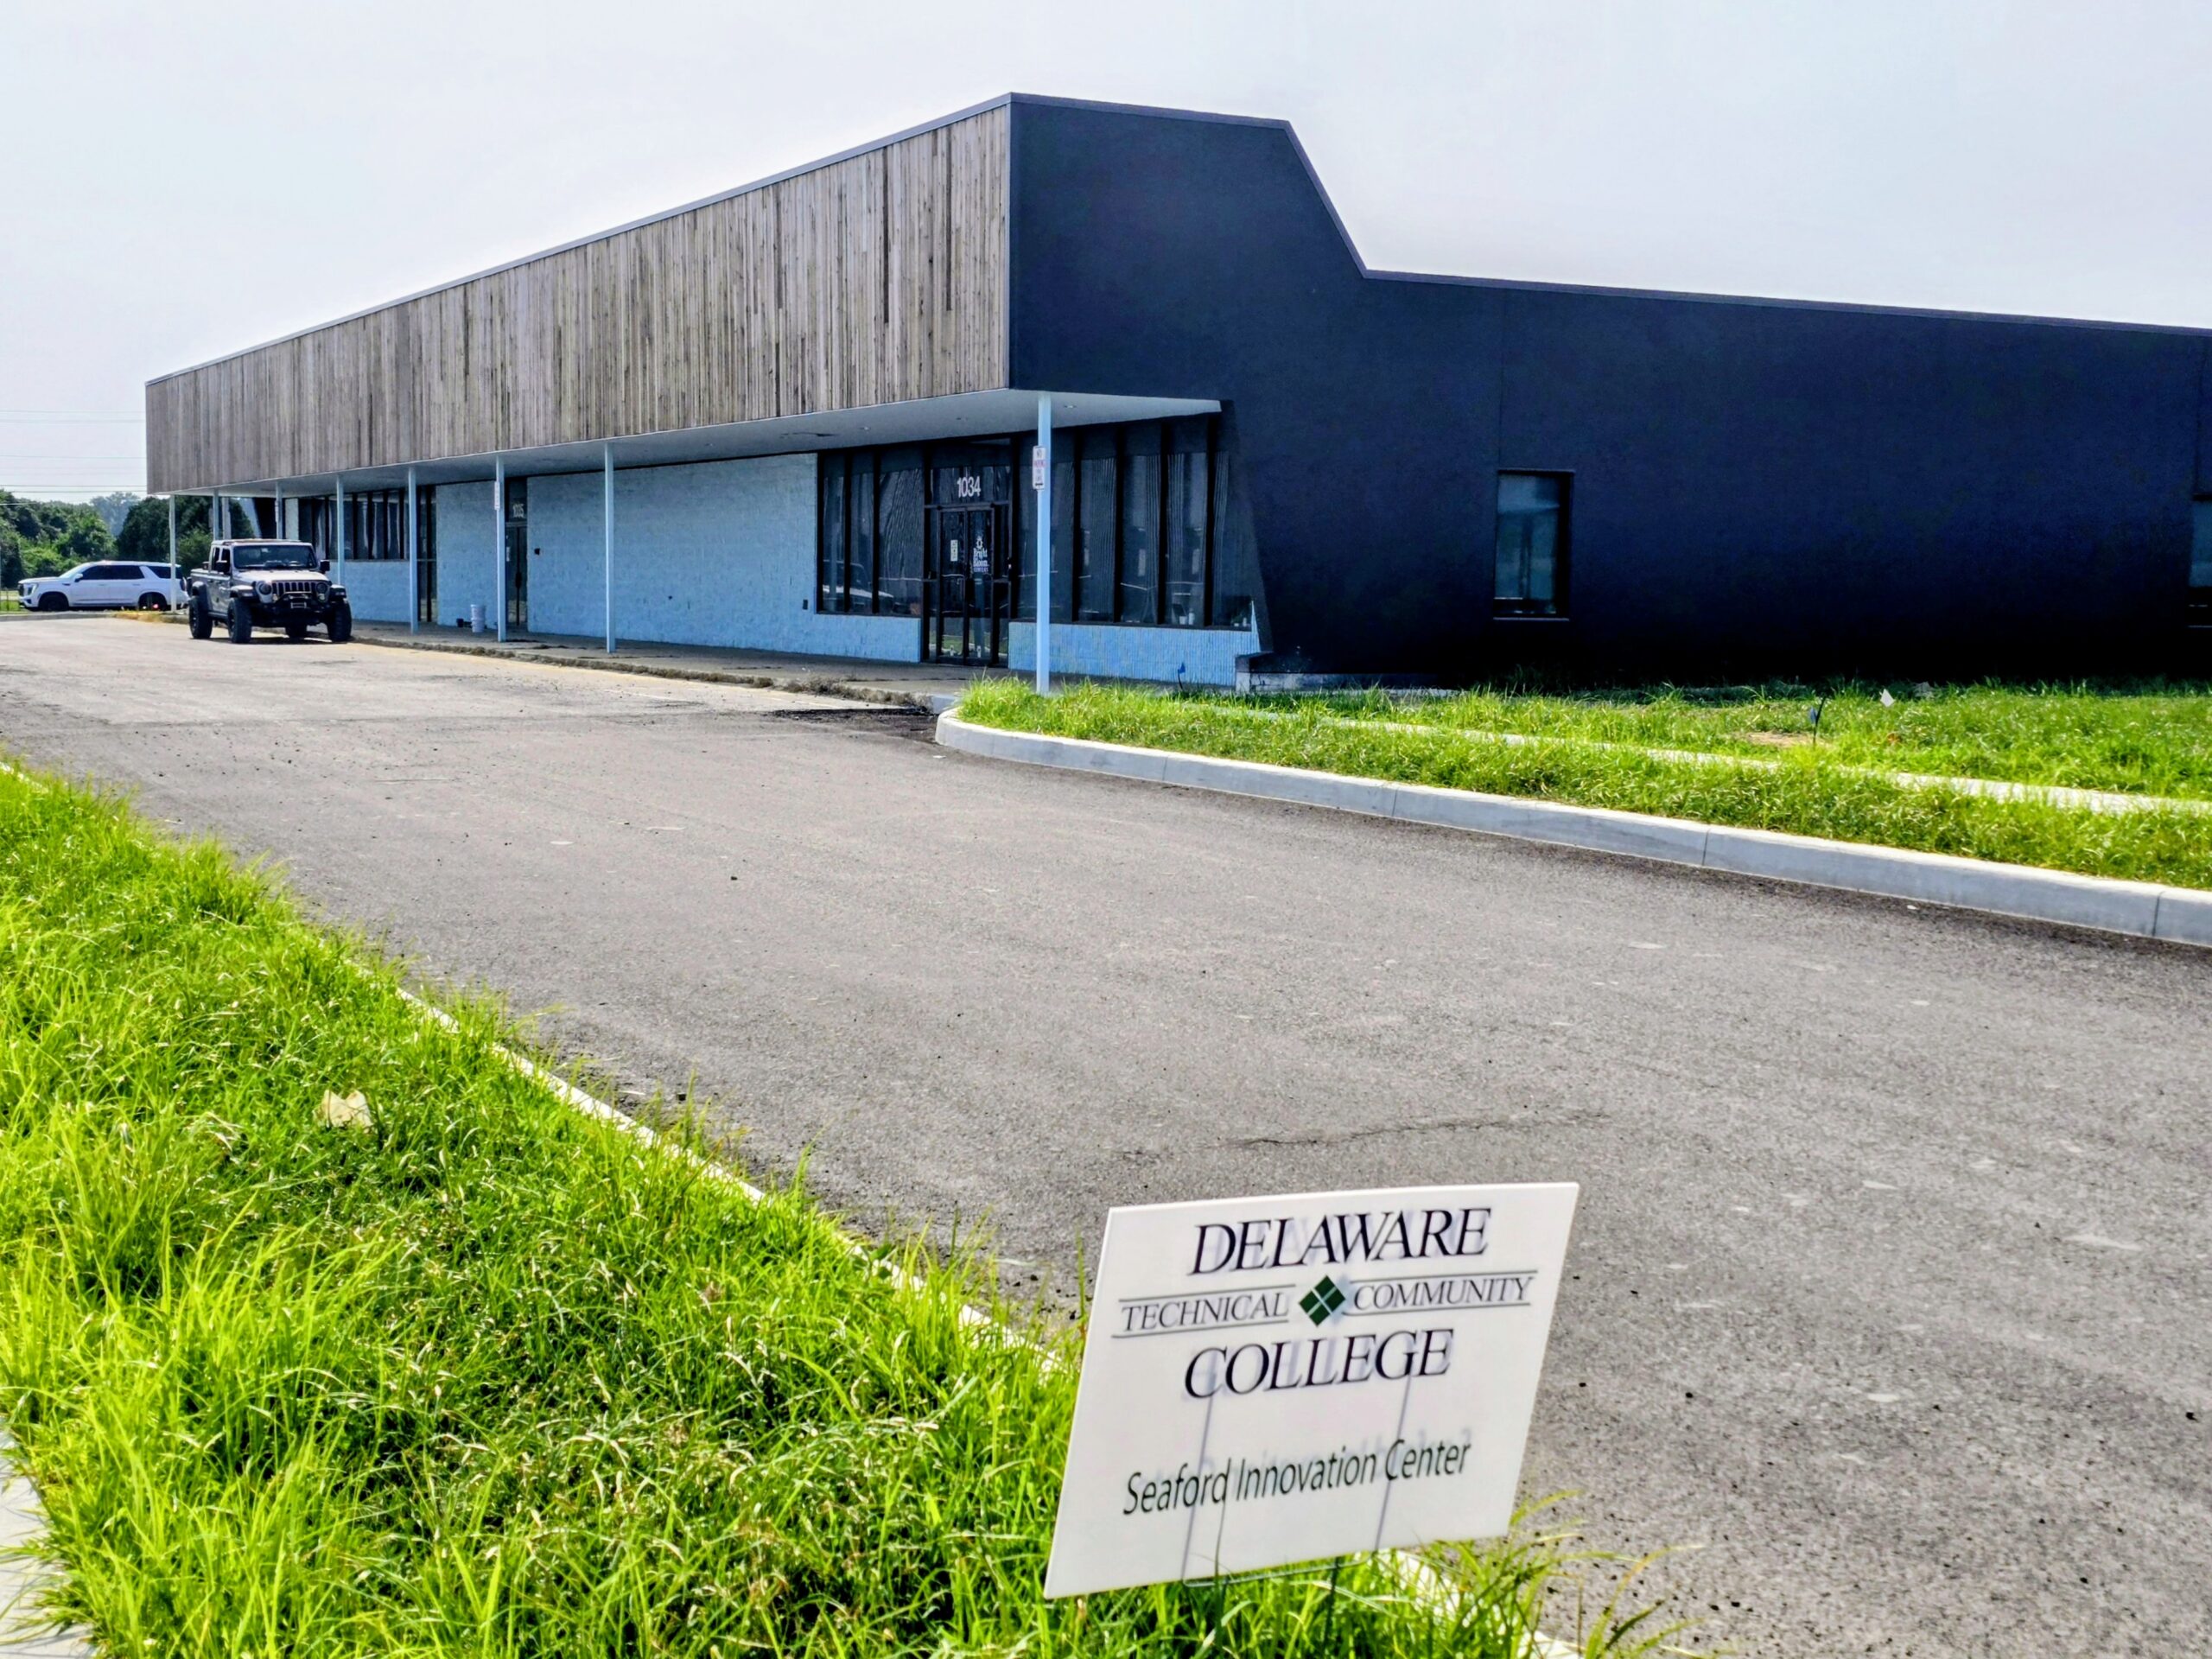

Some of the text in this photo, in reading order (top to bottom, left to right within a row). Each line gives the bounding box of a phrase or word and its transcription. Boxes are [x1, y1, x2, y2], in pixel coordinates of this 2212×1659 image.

[957, 475, 982, 498] 1034
[1190, 1208, 1492, 1275] DELAWARE
[1122, 1275, 1532, 1332] TECHNICAL COMMUNITY
[1184, 1329, 1454, 1399] COLLEGE
[1123, 1439, 1471, 1516] Seaford Innovation Center
